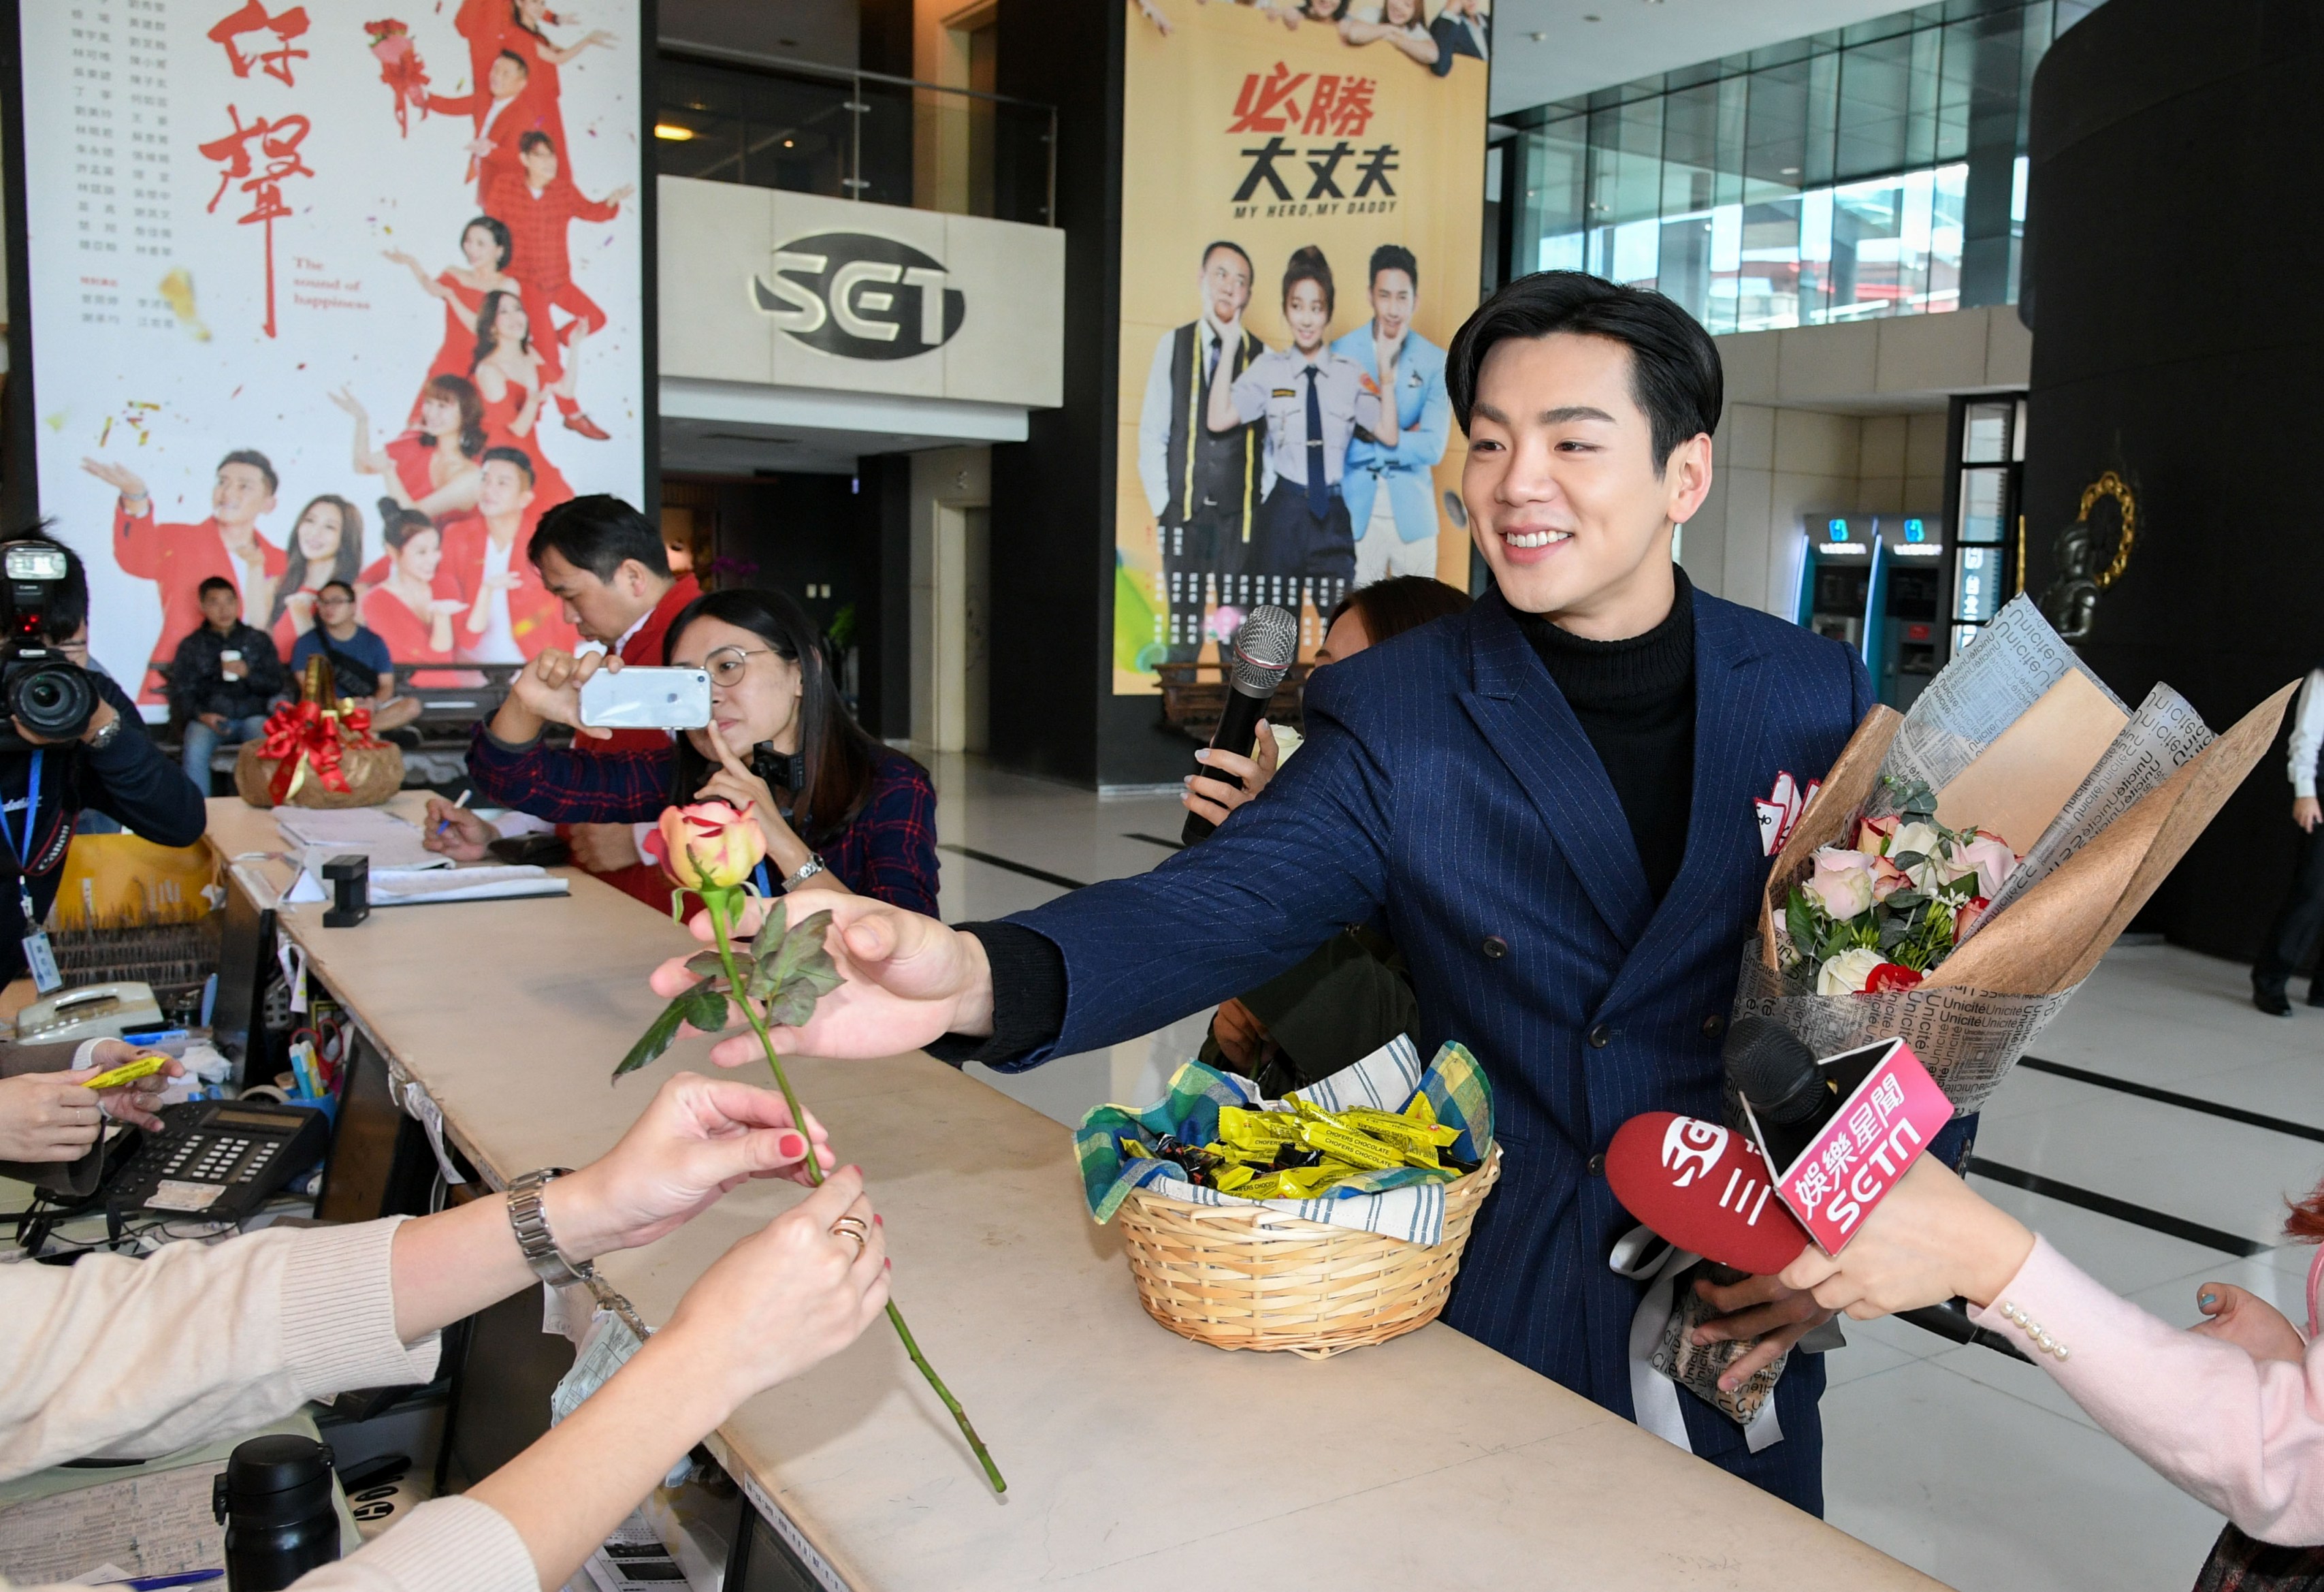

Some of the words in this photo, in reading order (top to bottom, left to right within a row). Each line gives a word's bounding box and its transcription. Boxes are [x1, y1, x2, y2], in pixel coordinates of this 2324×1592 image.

[1225, 61, 1376, 137] 必勝
[1231, 137, 1399, 203] 大丈夫
[1233, 206, 1257, 219] MY
[1347, 201, 1397, 214] DADDY
[293, 256, 325, 271] The
[293, 278, 340, 290] sound
[344, 281, 360, 291] of
[756, 249, 961, 345] SET
[293, 292, 371, 310] happiness
[1319, 1109, 1344, 1127] CHOFERS
[1325, 1138, 1354, 1152] CHOFERS
[1355, 1149, 1392, 1167] CHOCOLATE
[1326, 1130, 1354, 1143] CHOFERS
[1354, 1139, 1390, 1156] CHOCOLATE
[1794, 1072, 1905, 1221] 娛樂星聞
[1826, 1117, 1922, 1235] SETN
